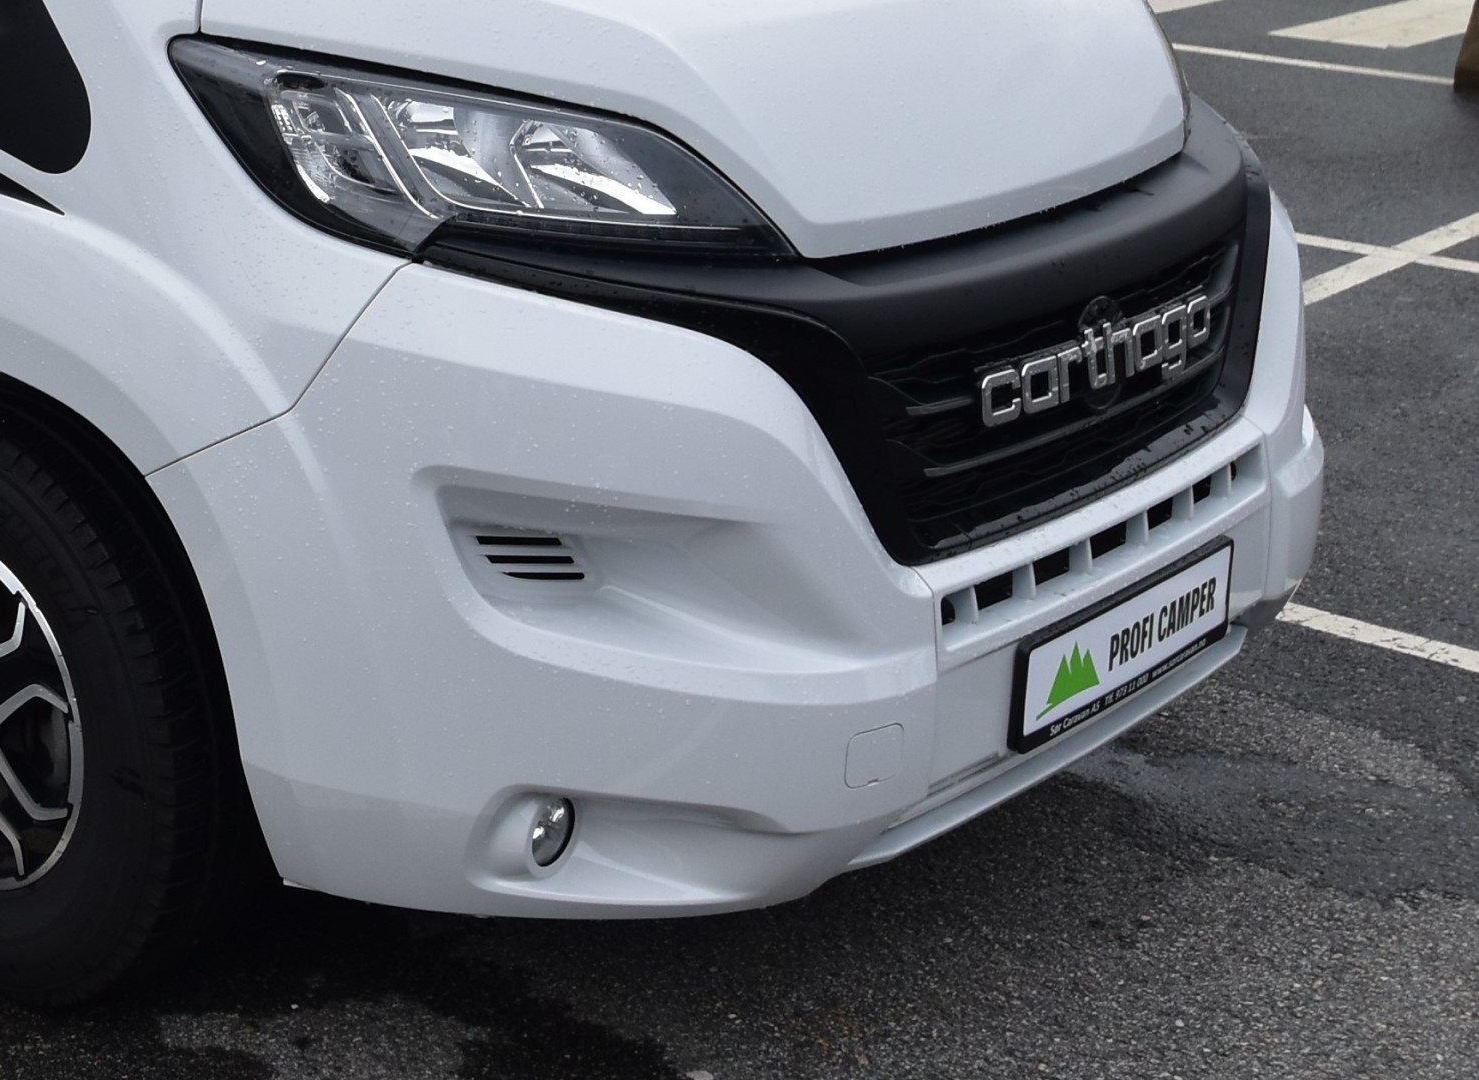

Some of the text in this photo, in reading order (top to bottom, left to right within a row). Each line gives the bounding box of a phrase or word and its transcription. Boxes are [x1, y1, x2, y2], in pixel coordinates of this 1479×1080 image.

[982, 294, 1211, 427] carthago
[1108, 577, 1217, 672] PROFI CAMPER
[1062, 707, 1091, 730] Caravan
[1090, 700, 1101, 715] AS
